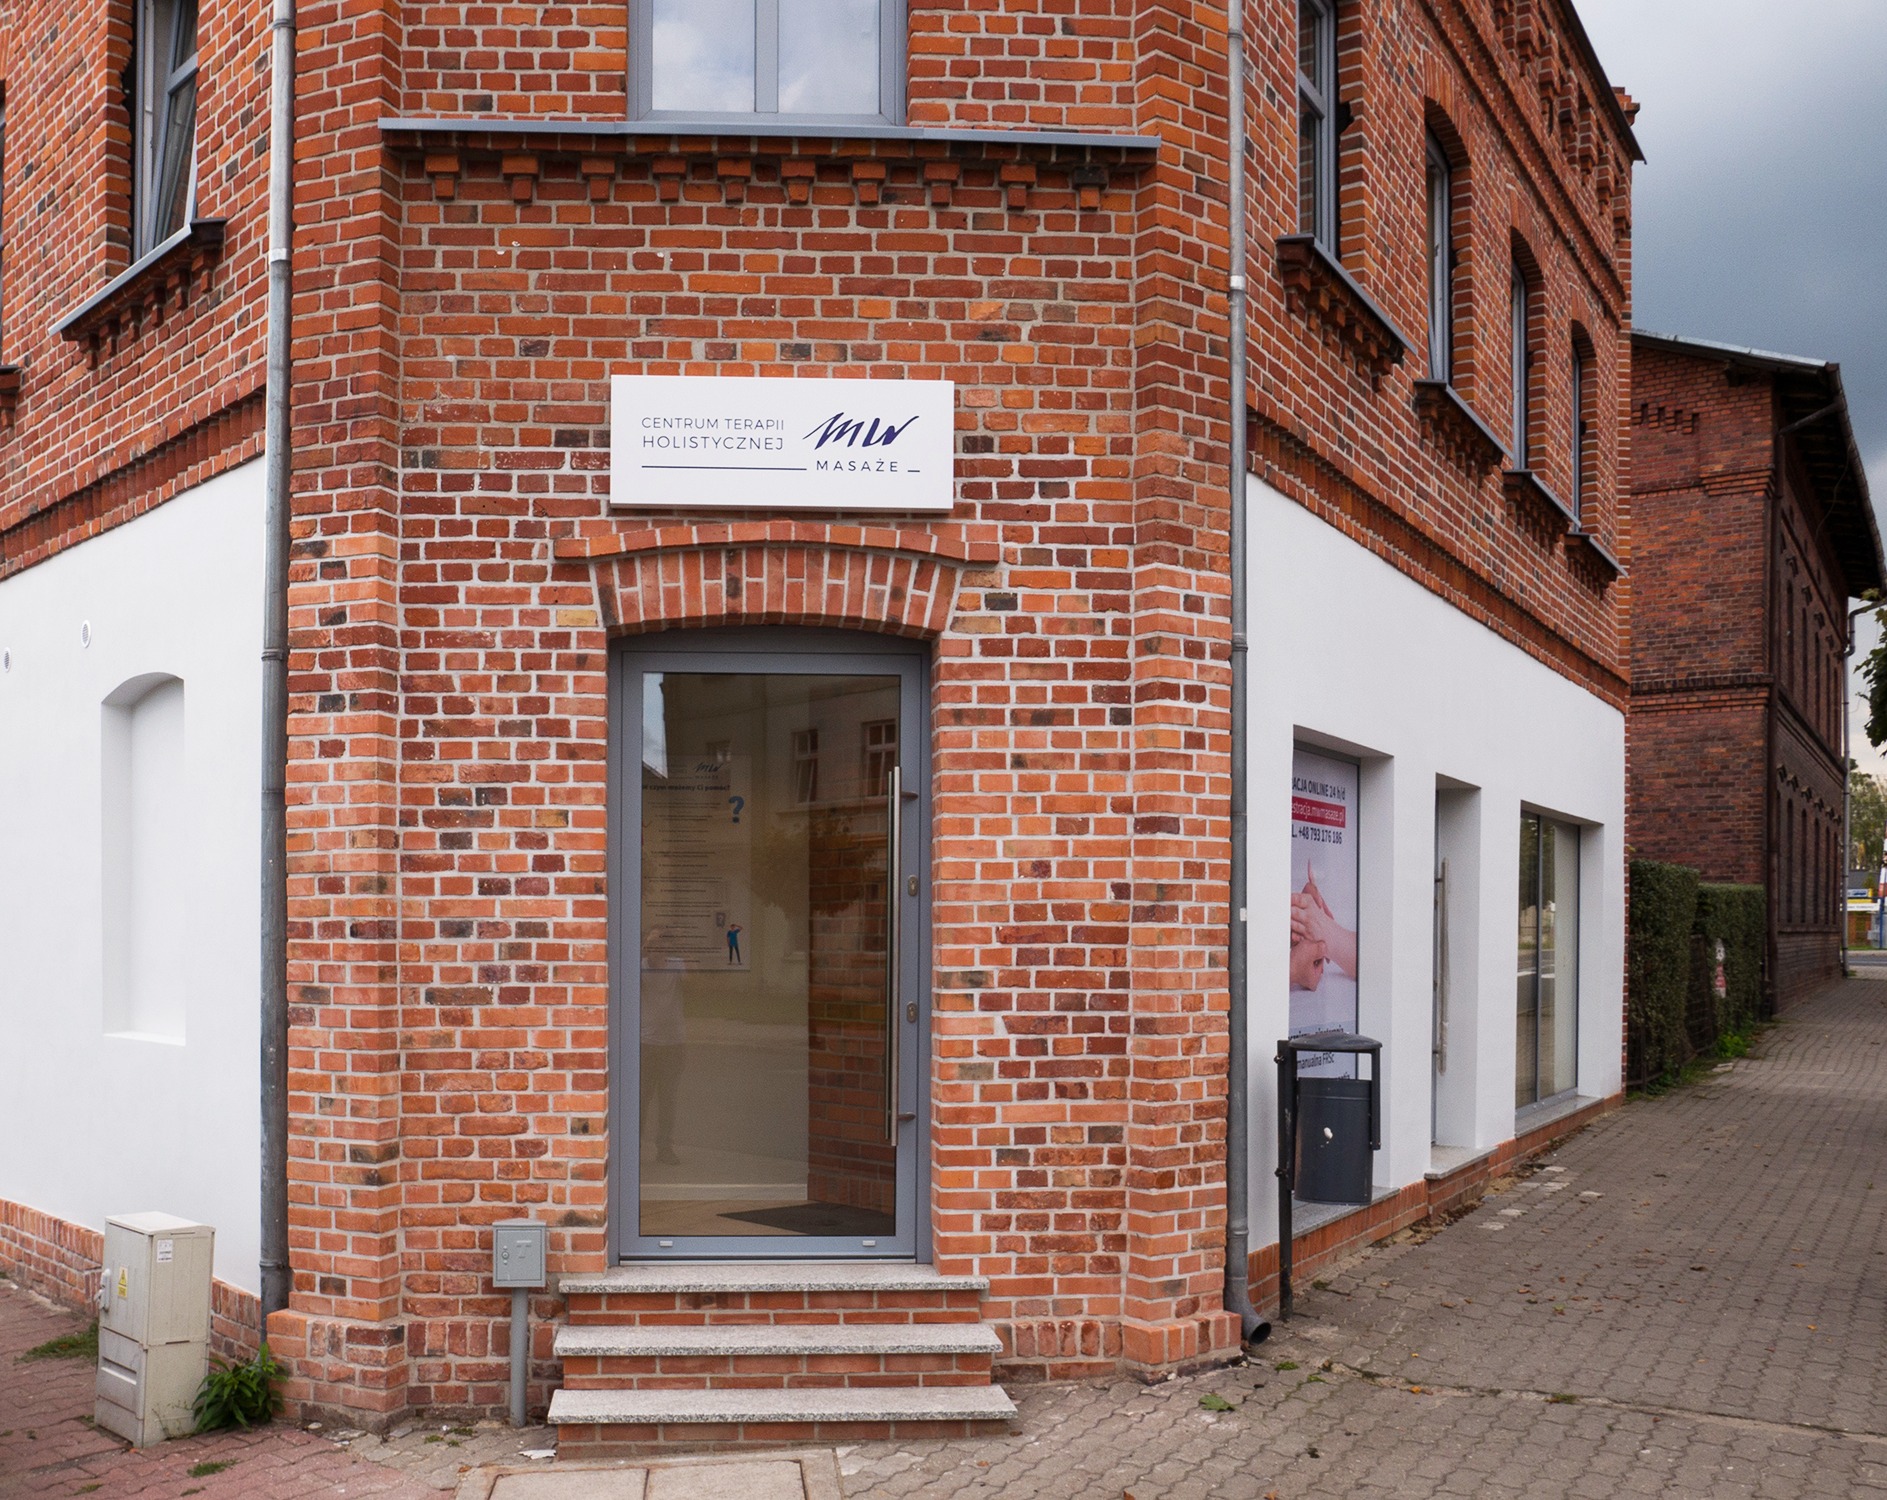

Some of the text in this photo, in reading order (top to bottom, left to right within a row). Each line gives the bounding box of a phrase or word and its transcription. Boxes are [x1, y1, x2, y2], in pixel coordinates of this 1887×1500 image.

[641, 416, 785, 431] CENTRUM TERAPII
[641, 435, 784, 451] HOLISTYCZNEJ
[816, 457, 899, 473] MASAŻE
[1308, 780, 1328, 797] ONLINE
[1329, 785, 1336, 798] 24
[1299, 826, 1309, 840] +48
[1310, 827, 1321, 841] 793
